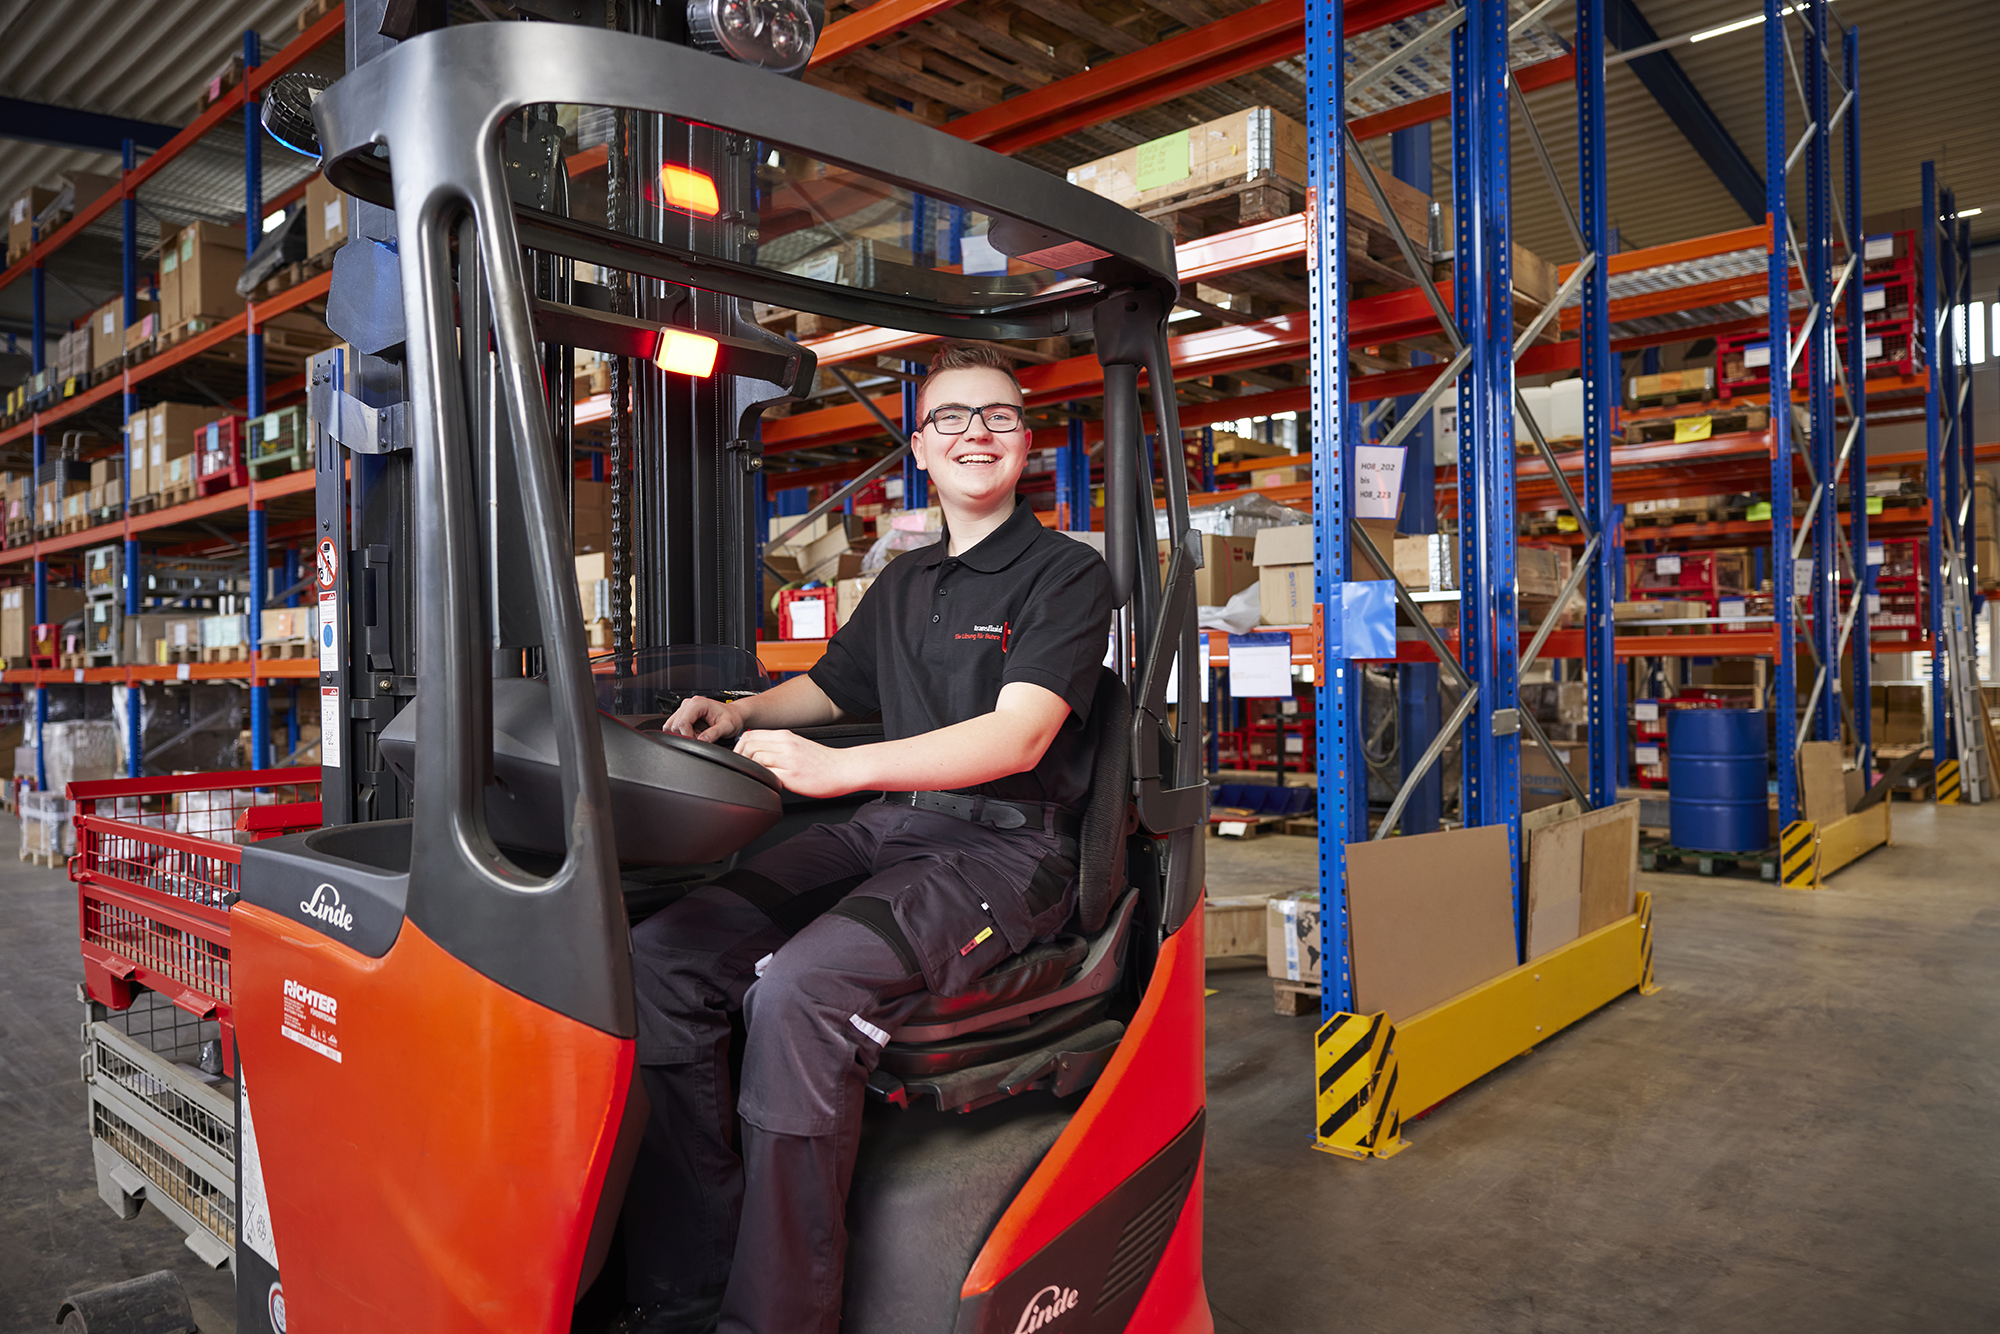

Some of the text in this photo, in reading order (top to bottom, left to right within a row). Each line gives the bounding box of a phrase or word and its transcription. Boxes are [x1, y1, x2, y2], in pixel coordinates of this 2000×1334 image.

[1361, 462, 1395, 472] H08_202
[1360, 491, 1391, 500] H08_223
[300, 883, 353, 931] Linde
[1013, 1284, 1079, 1334] Linde
